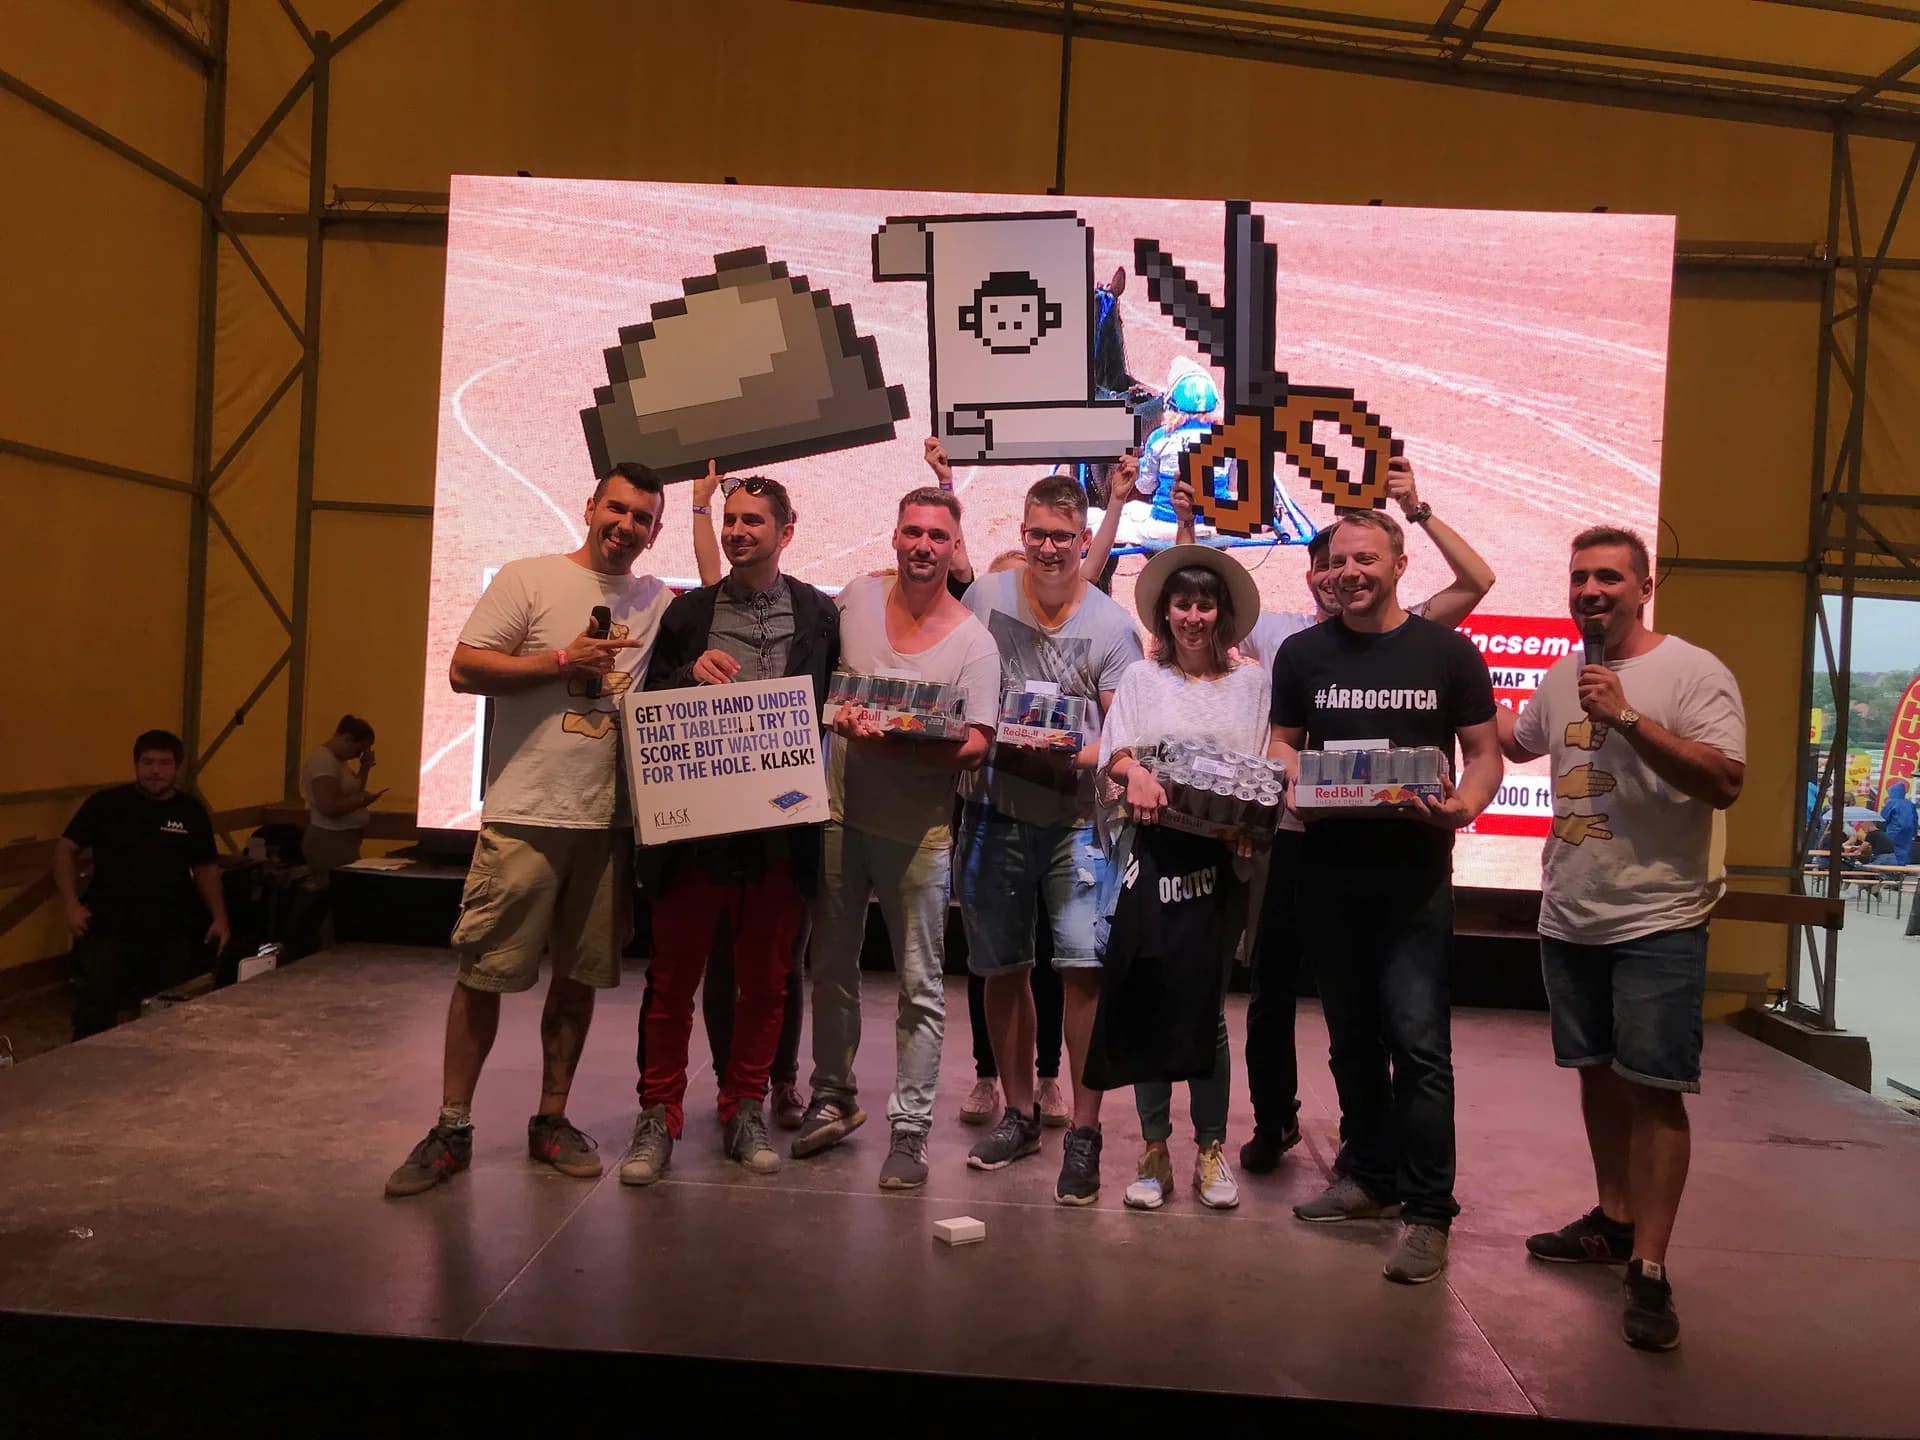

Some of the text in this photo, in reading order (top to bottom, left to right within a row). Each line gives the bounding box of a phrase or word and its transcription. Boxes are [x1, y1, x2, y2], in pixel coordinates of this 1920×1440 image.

[1492, 672, 1525, 687] NAP
[635, 705, 662, 724] GET
[666, 701, 708, 721] YOUR
[712, 696, 754, 715] HAND
[758, 690, 807, 710] UNDER
[1314, 684, 1438, 710] #ÁRBOCUTCA
[637, 724, 676, 744] THAT
[758, 712, 786, 731] TRY
[792, 710, 810, 728] TO
[641, 728, 812, 765] SCORE BUT WATCH OUT
[642, 748, 816, 785] FOR THE HOLE. KLASK!
[1535, 787, 1550, 808] ft
[653, 807, 691, 828] KLASK
